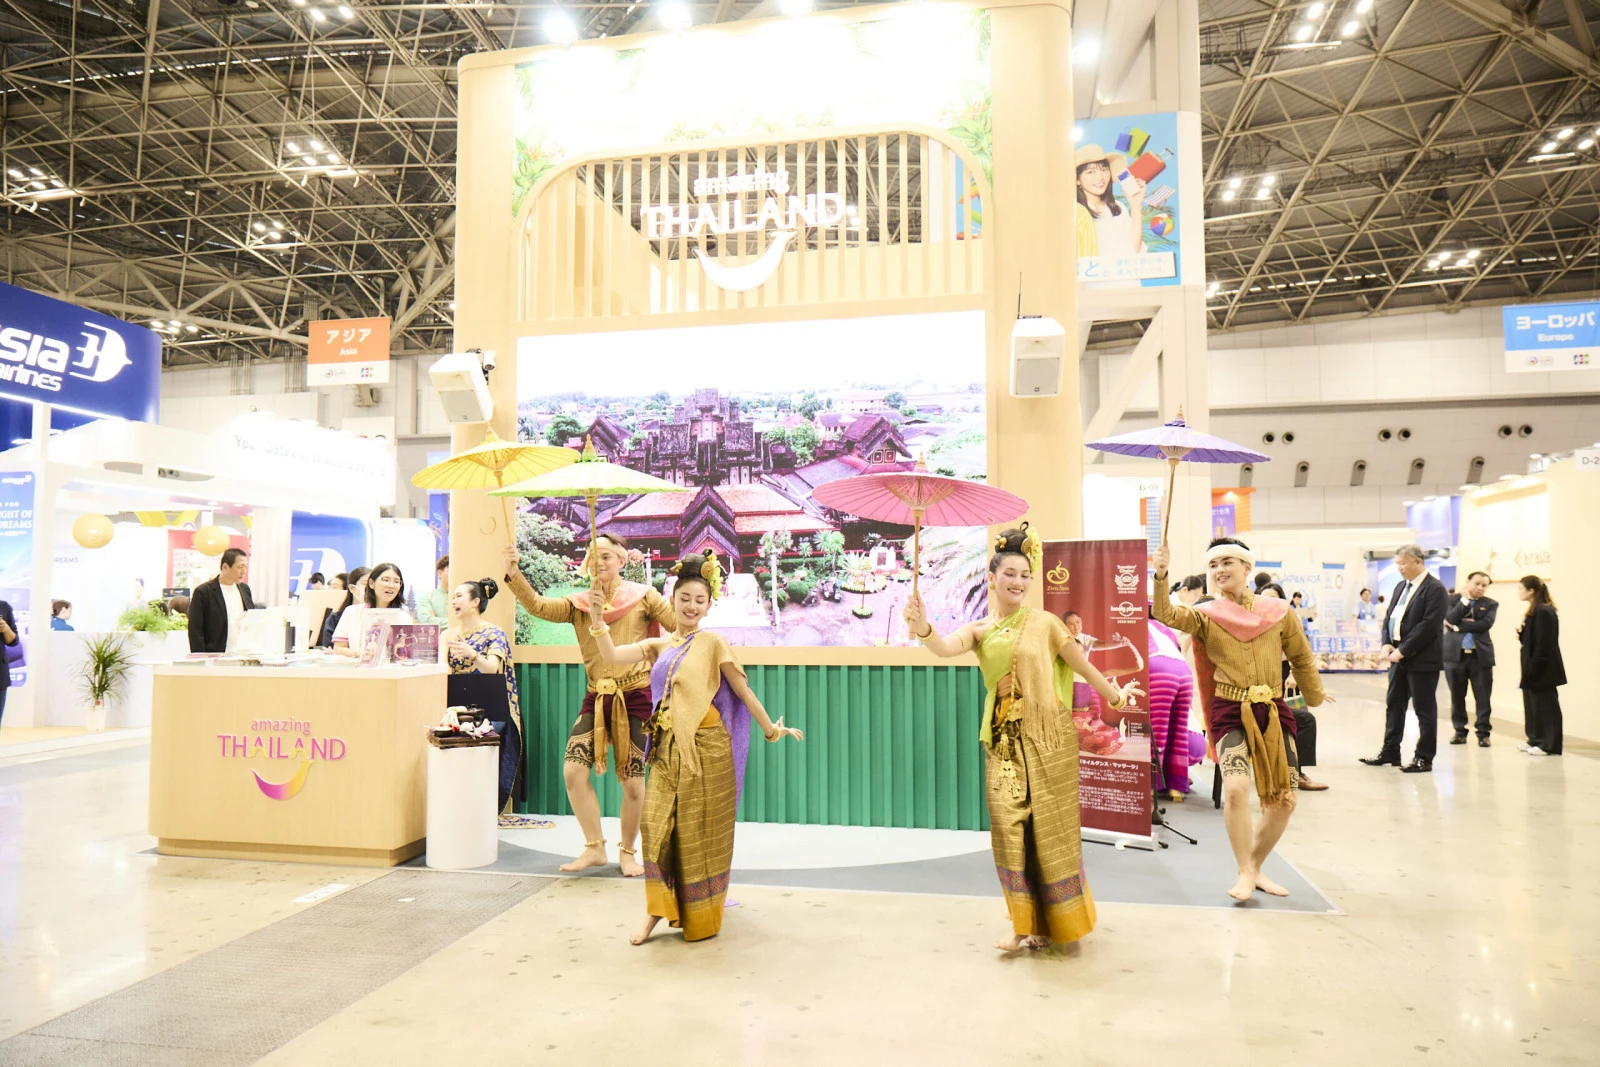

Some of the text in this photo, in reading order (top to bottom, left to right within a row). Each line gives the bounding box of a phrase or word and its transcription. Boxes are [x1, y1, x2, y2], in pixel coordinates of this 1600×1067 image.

[640, 193, 846, 237] THAILAND
[1516, 311, 1596, 330] ヨーロッパ
[326, 328, 371, 344] アジア
[1537, 333, 1574, 342] Europe
[0, 326, 70, 373] sia
[21, 510, 32, 518] OF
[251, 716, 311, 736] amazing
[217, 735, 346, 760] THAILAND
